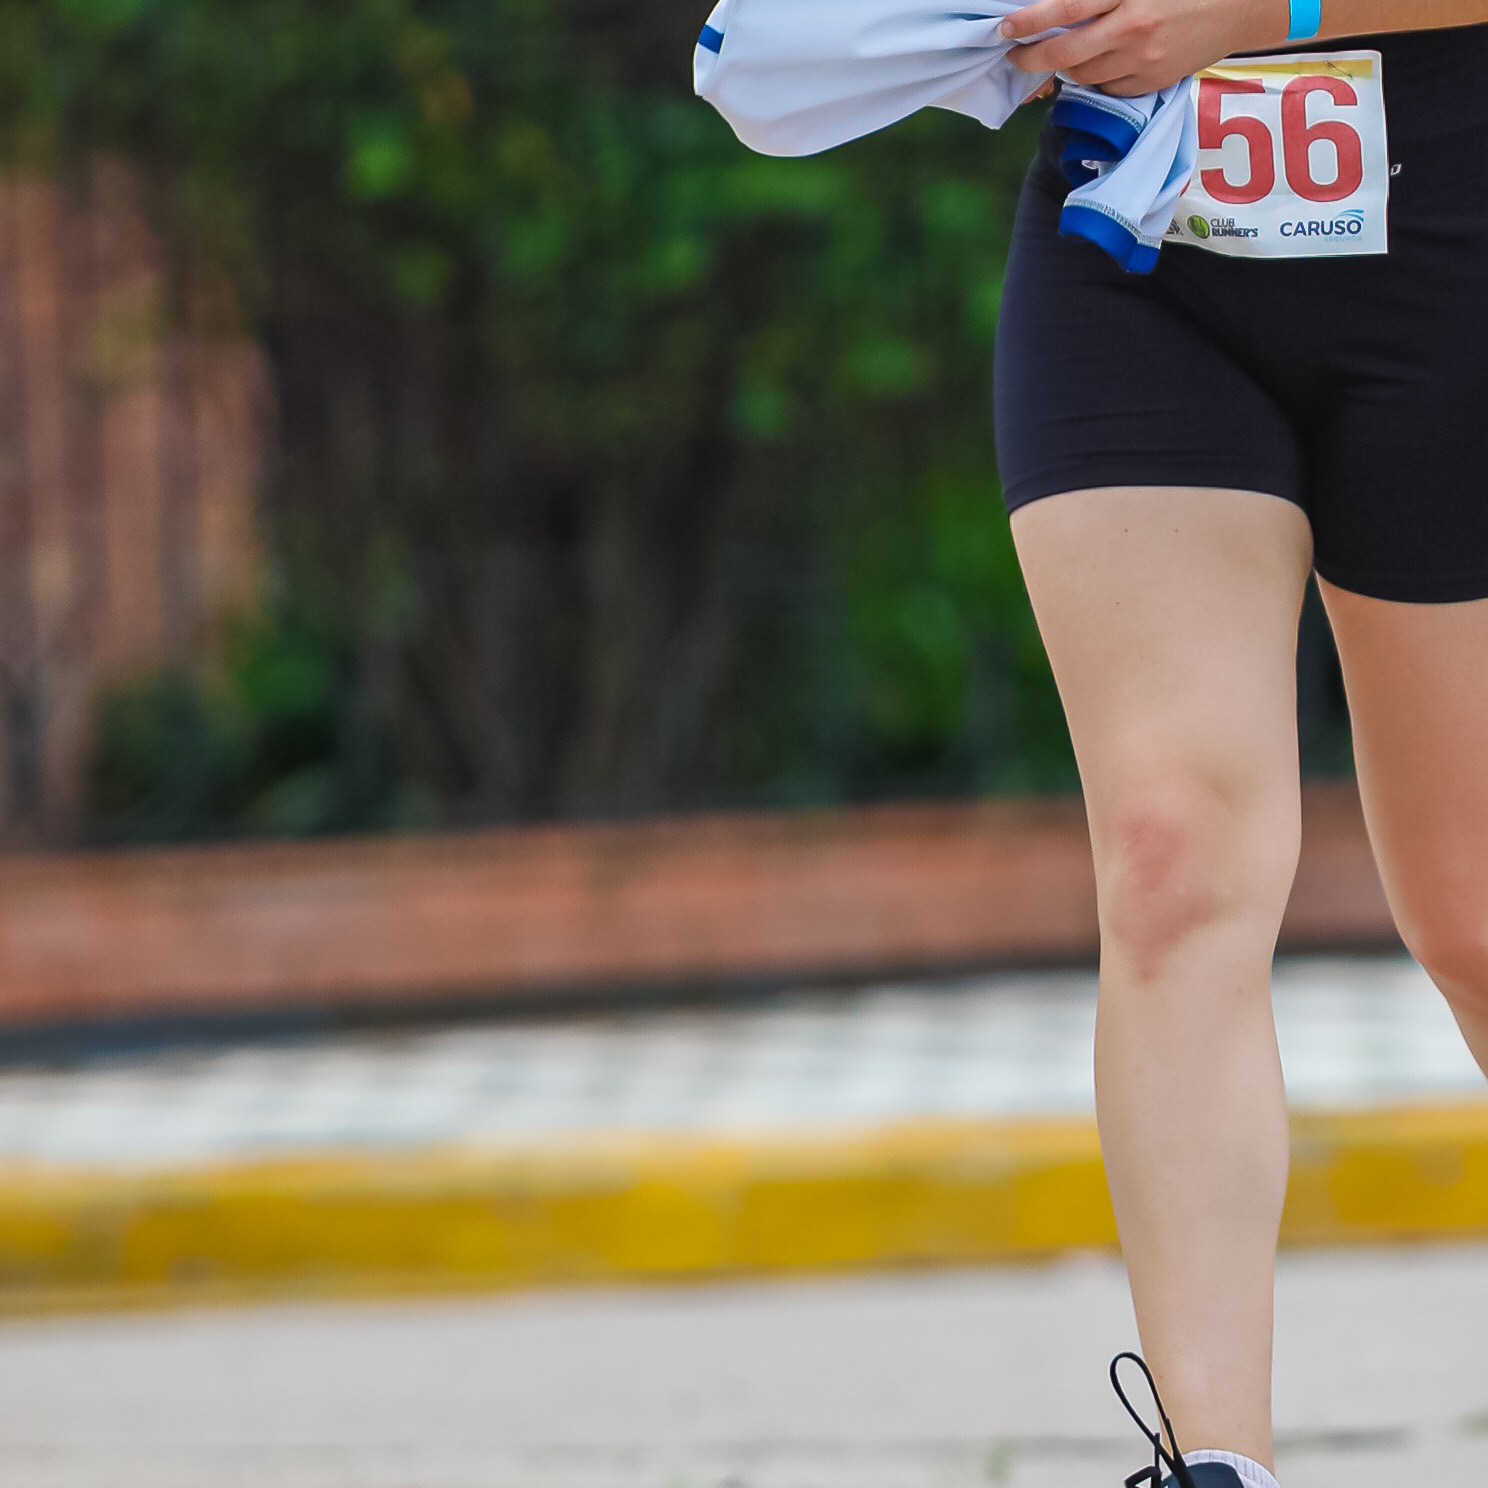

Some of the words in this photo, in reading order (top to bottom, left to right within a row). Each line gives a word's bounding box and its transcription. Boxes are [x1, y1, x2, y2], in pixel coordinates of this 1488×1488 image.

[1180, 75, 1364, 205] 56
[1210, 217, 1235, 228] CLUB
[1279, 219, 1362, 237] CARUSO
[1211, 227, 1259, 238] RUNNER'S
